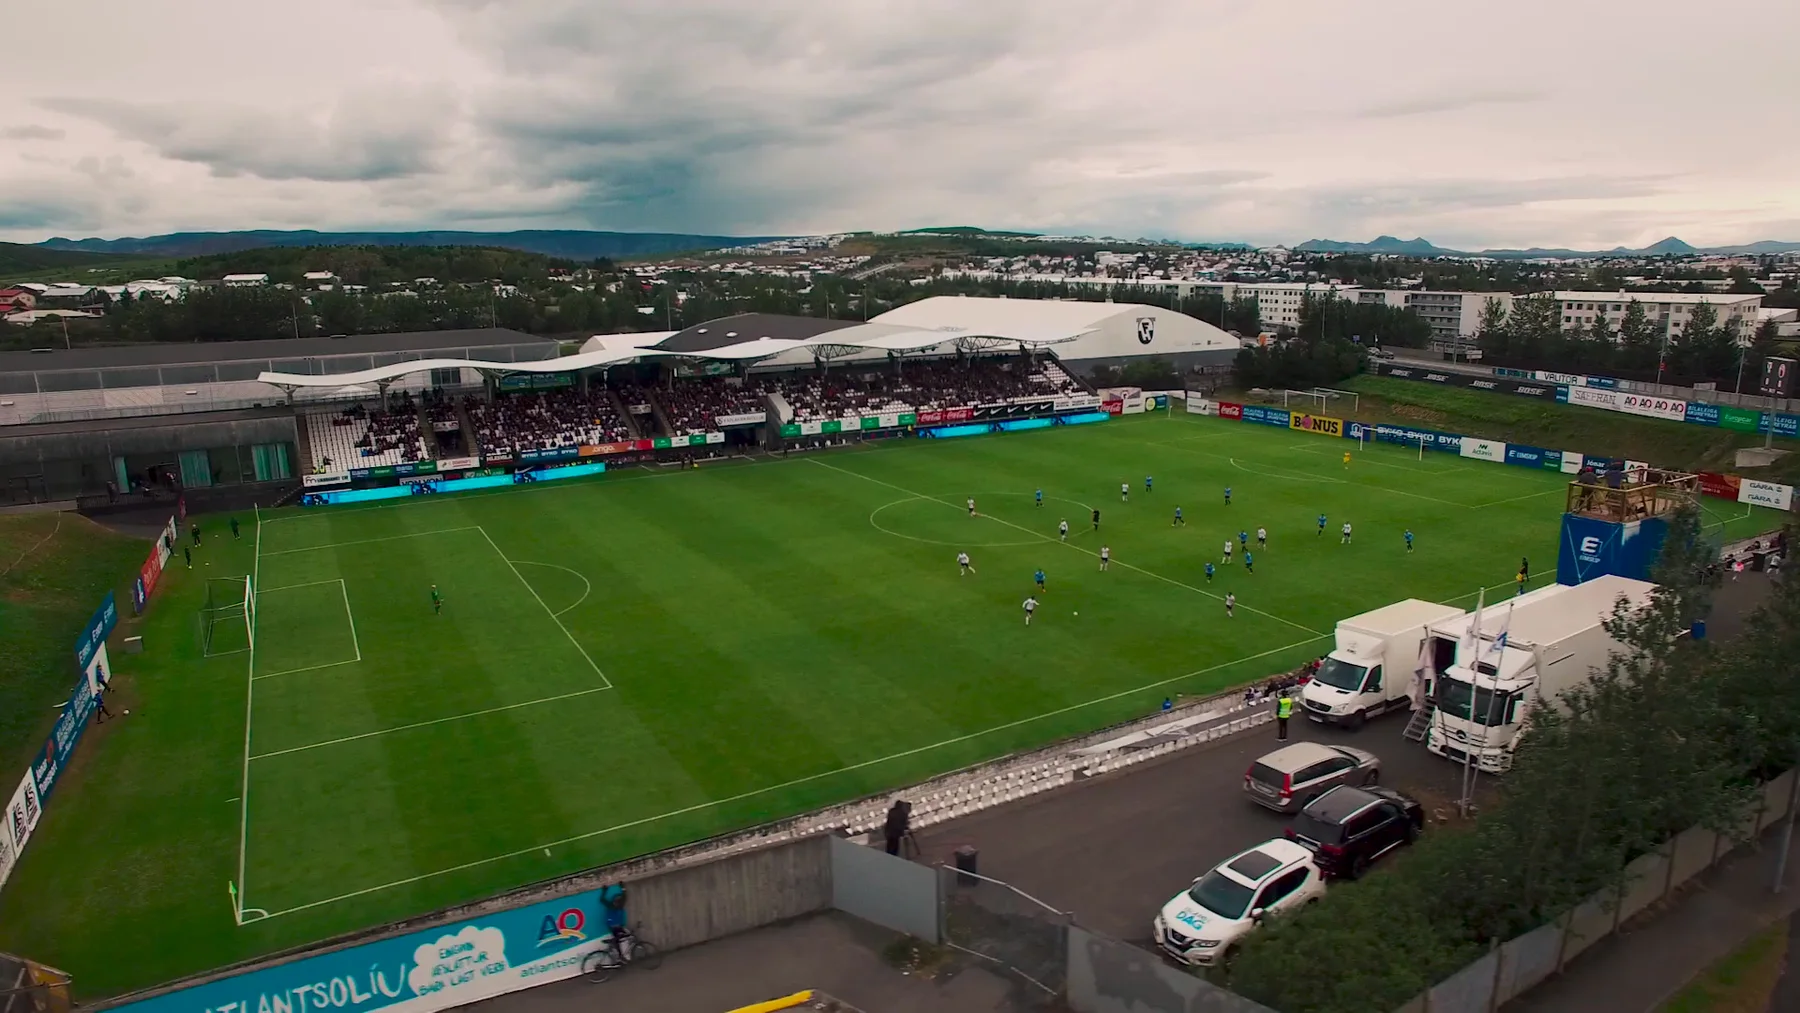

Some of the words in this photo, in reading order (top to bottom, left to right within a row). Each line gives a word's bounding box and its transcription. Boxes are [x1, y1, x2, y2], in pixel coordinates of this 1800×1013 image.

[1389, 369, 1411, 378] BOSE
[1423, 373, 1450, 383] BOSE
[1544, 372, 1578, 385] VALITOR
[1470, 380, 1498, 390] BOSE
[1514, 387, 1547, 396] BOSE
[1574, 390, 1616, 406] SAFFRAN
[1100, 402, 1122, 412] Coca-Cola
[1220, 407, 1240, 417] Coca-Cola
[920, 412, 941, 422] Coca-Cola
[946, 409, 967, 420] Coca-Cola
[1724, 414, 1752, 423] Europcar
[1761, 415, 1797, 425] BÍLEIGA
[1760, 420, 1797, 430] AKREYRAR
[1406, 431, 1435, 442] BYKO
[1472, 448, 1493, 457] Actavis
[1586, 459, 1606, 468] Jónar
[520, 955, 584, 978] atlantsol
[203, 963, 406, 1013] ANTSOLÍU
